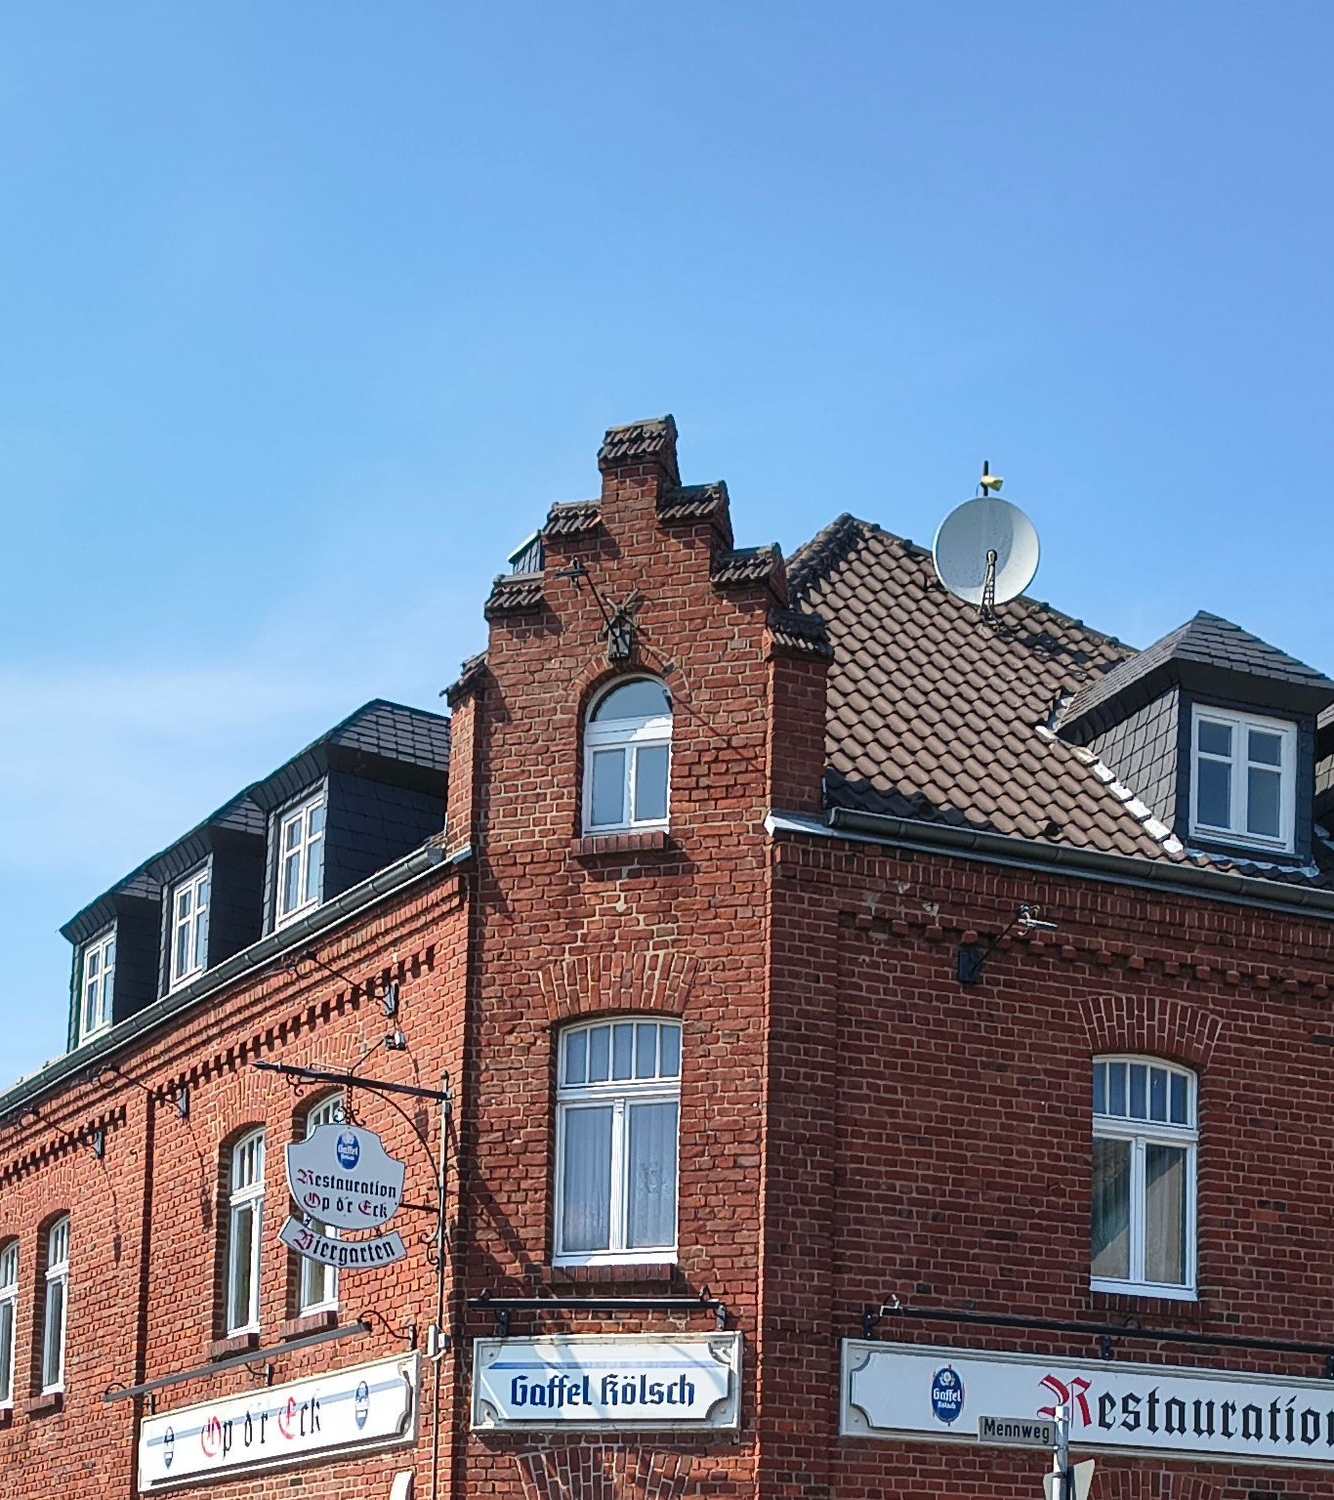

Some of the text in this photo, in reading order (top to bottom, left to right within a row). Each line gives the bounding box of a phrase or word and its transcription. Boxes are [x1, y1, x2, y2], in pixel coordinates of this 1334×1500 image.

[297, 1169, 397, 1199] Restauration
[303, 1192, 330, 1212] Op
[358, 1200, 388, 1219] Eck
[293, 1229, 396, 1266] Biergarten
[511, 1373, 695, 1408] Gaffel Kölsch
[933, 1387, 962, 1402] Gaffel
[200, 1415, 234, 1460] Op
[278, 1395, 321, 1440] Eck
[983, 1418, 1051, 1445] Mennweg
